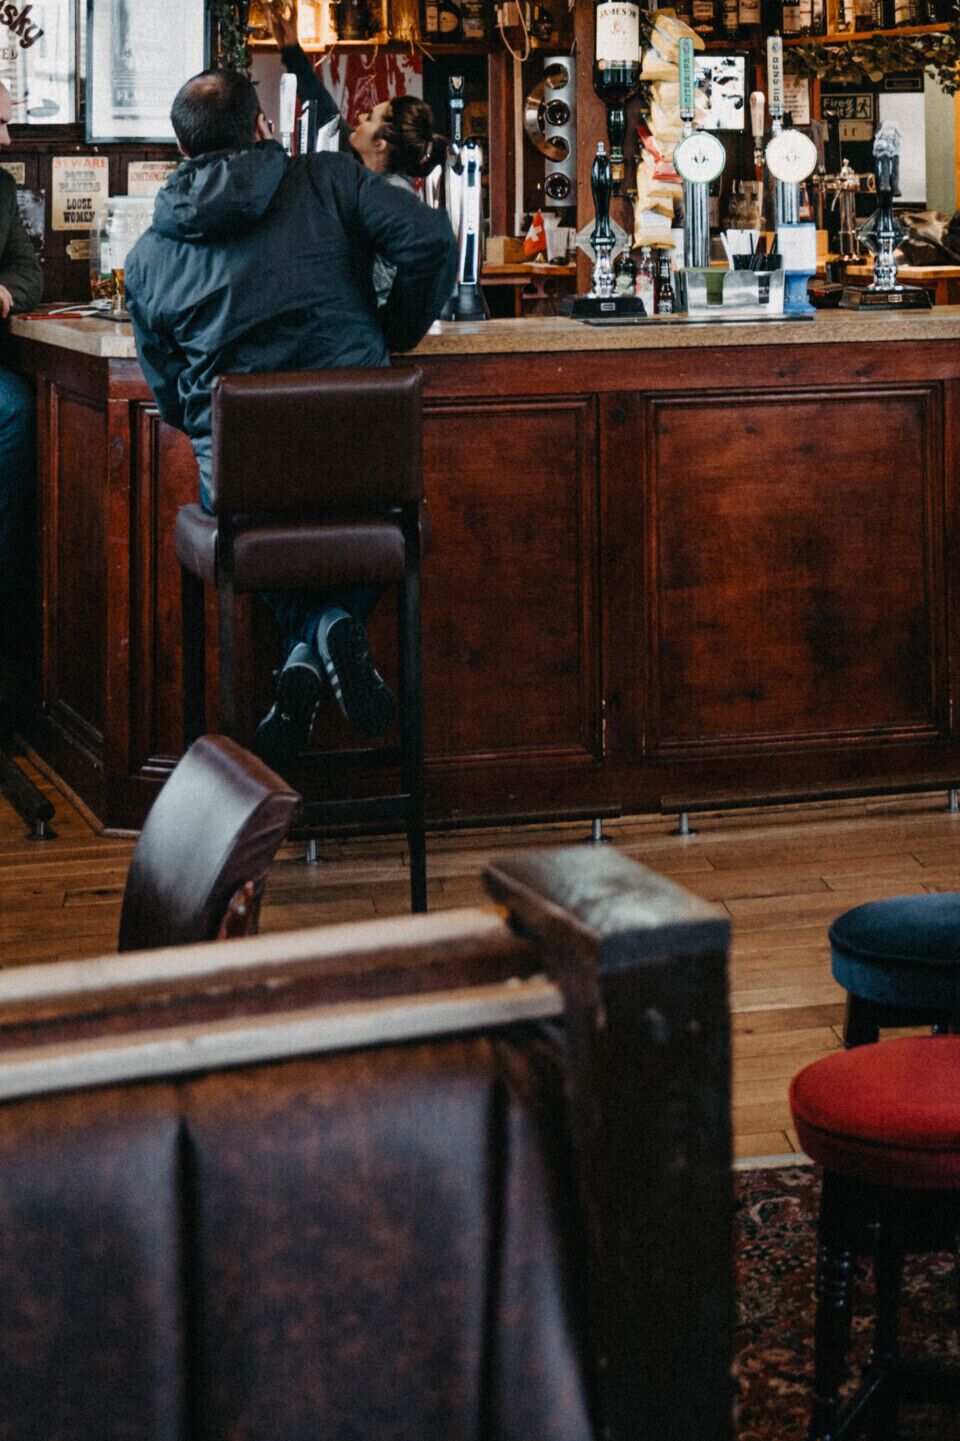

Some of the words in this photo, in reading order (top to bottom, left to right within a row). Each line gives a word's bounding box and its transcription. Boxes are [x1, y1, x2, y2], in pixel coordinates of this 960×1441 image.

[773, 57, 781, 103] PILSNER
[66, 198, 93, 211] LOOSE
[63, 211, 96, 224] WOMEN
